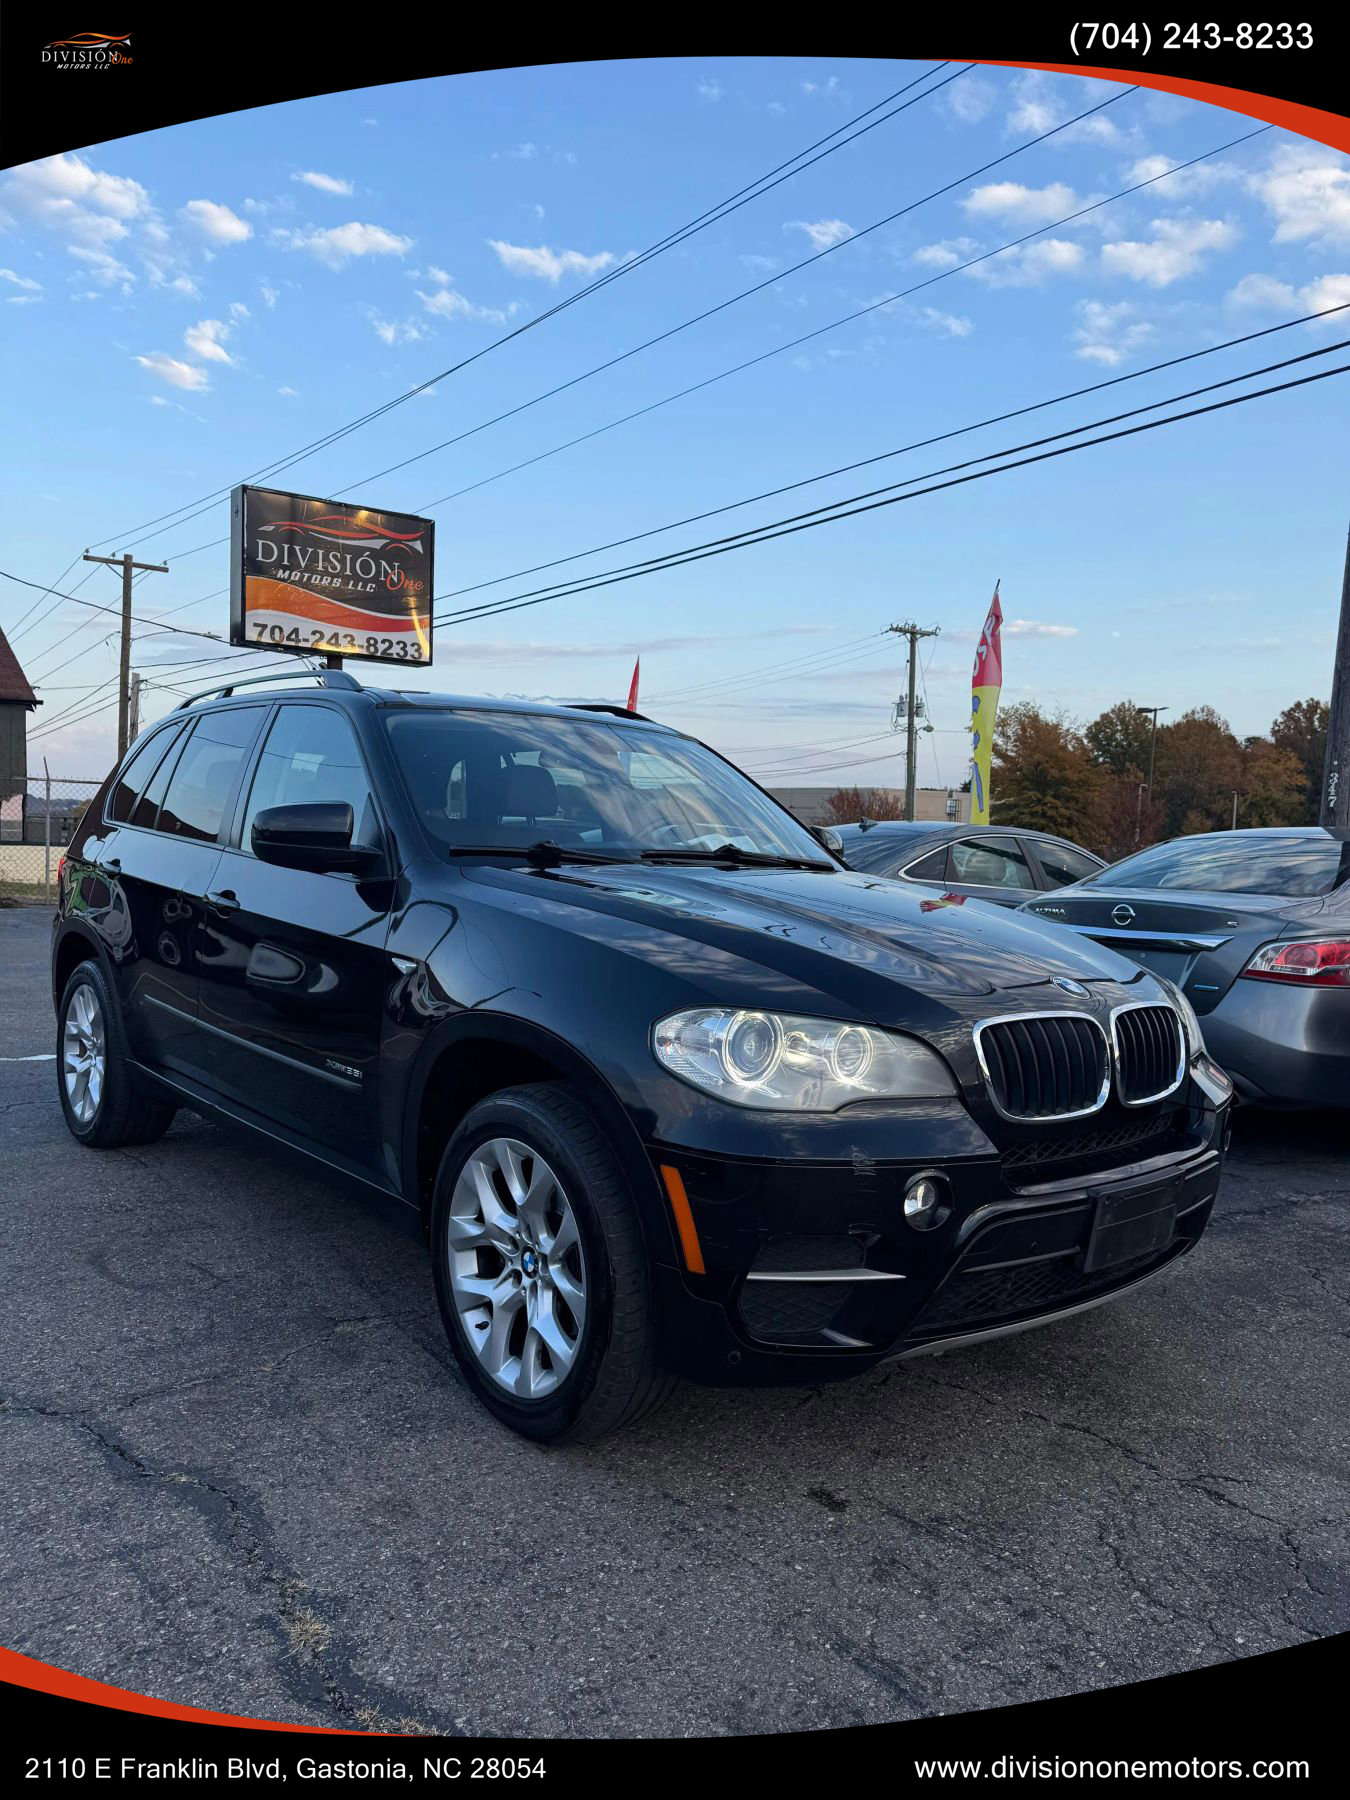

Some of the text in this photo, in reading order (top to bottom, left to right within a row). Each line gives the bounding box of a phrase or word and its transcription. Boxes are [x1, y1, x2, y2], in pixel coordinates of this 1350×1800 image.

[256, 539, 424, 591] DIVISIÓN One
[276, 569, 376, 593] MOTORS LLC
[252, 622, 423, 660] 704-243-8233
[1327, 772, 1339, 808] 347
[1034, 907, 1066, 916] ALTIMA
